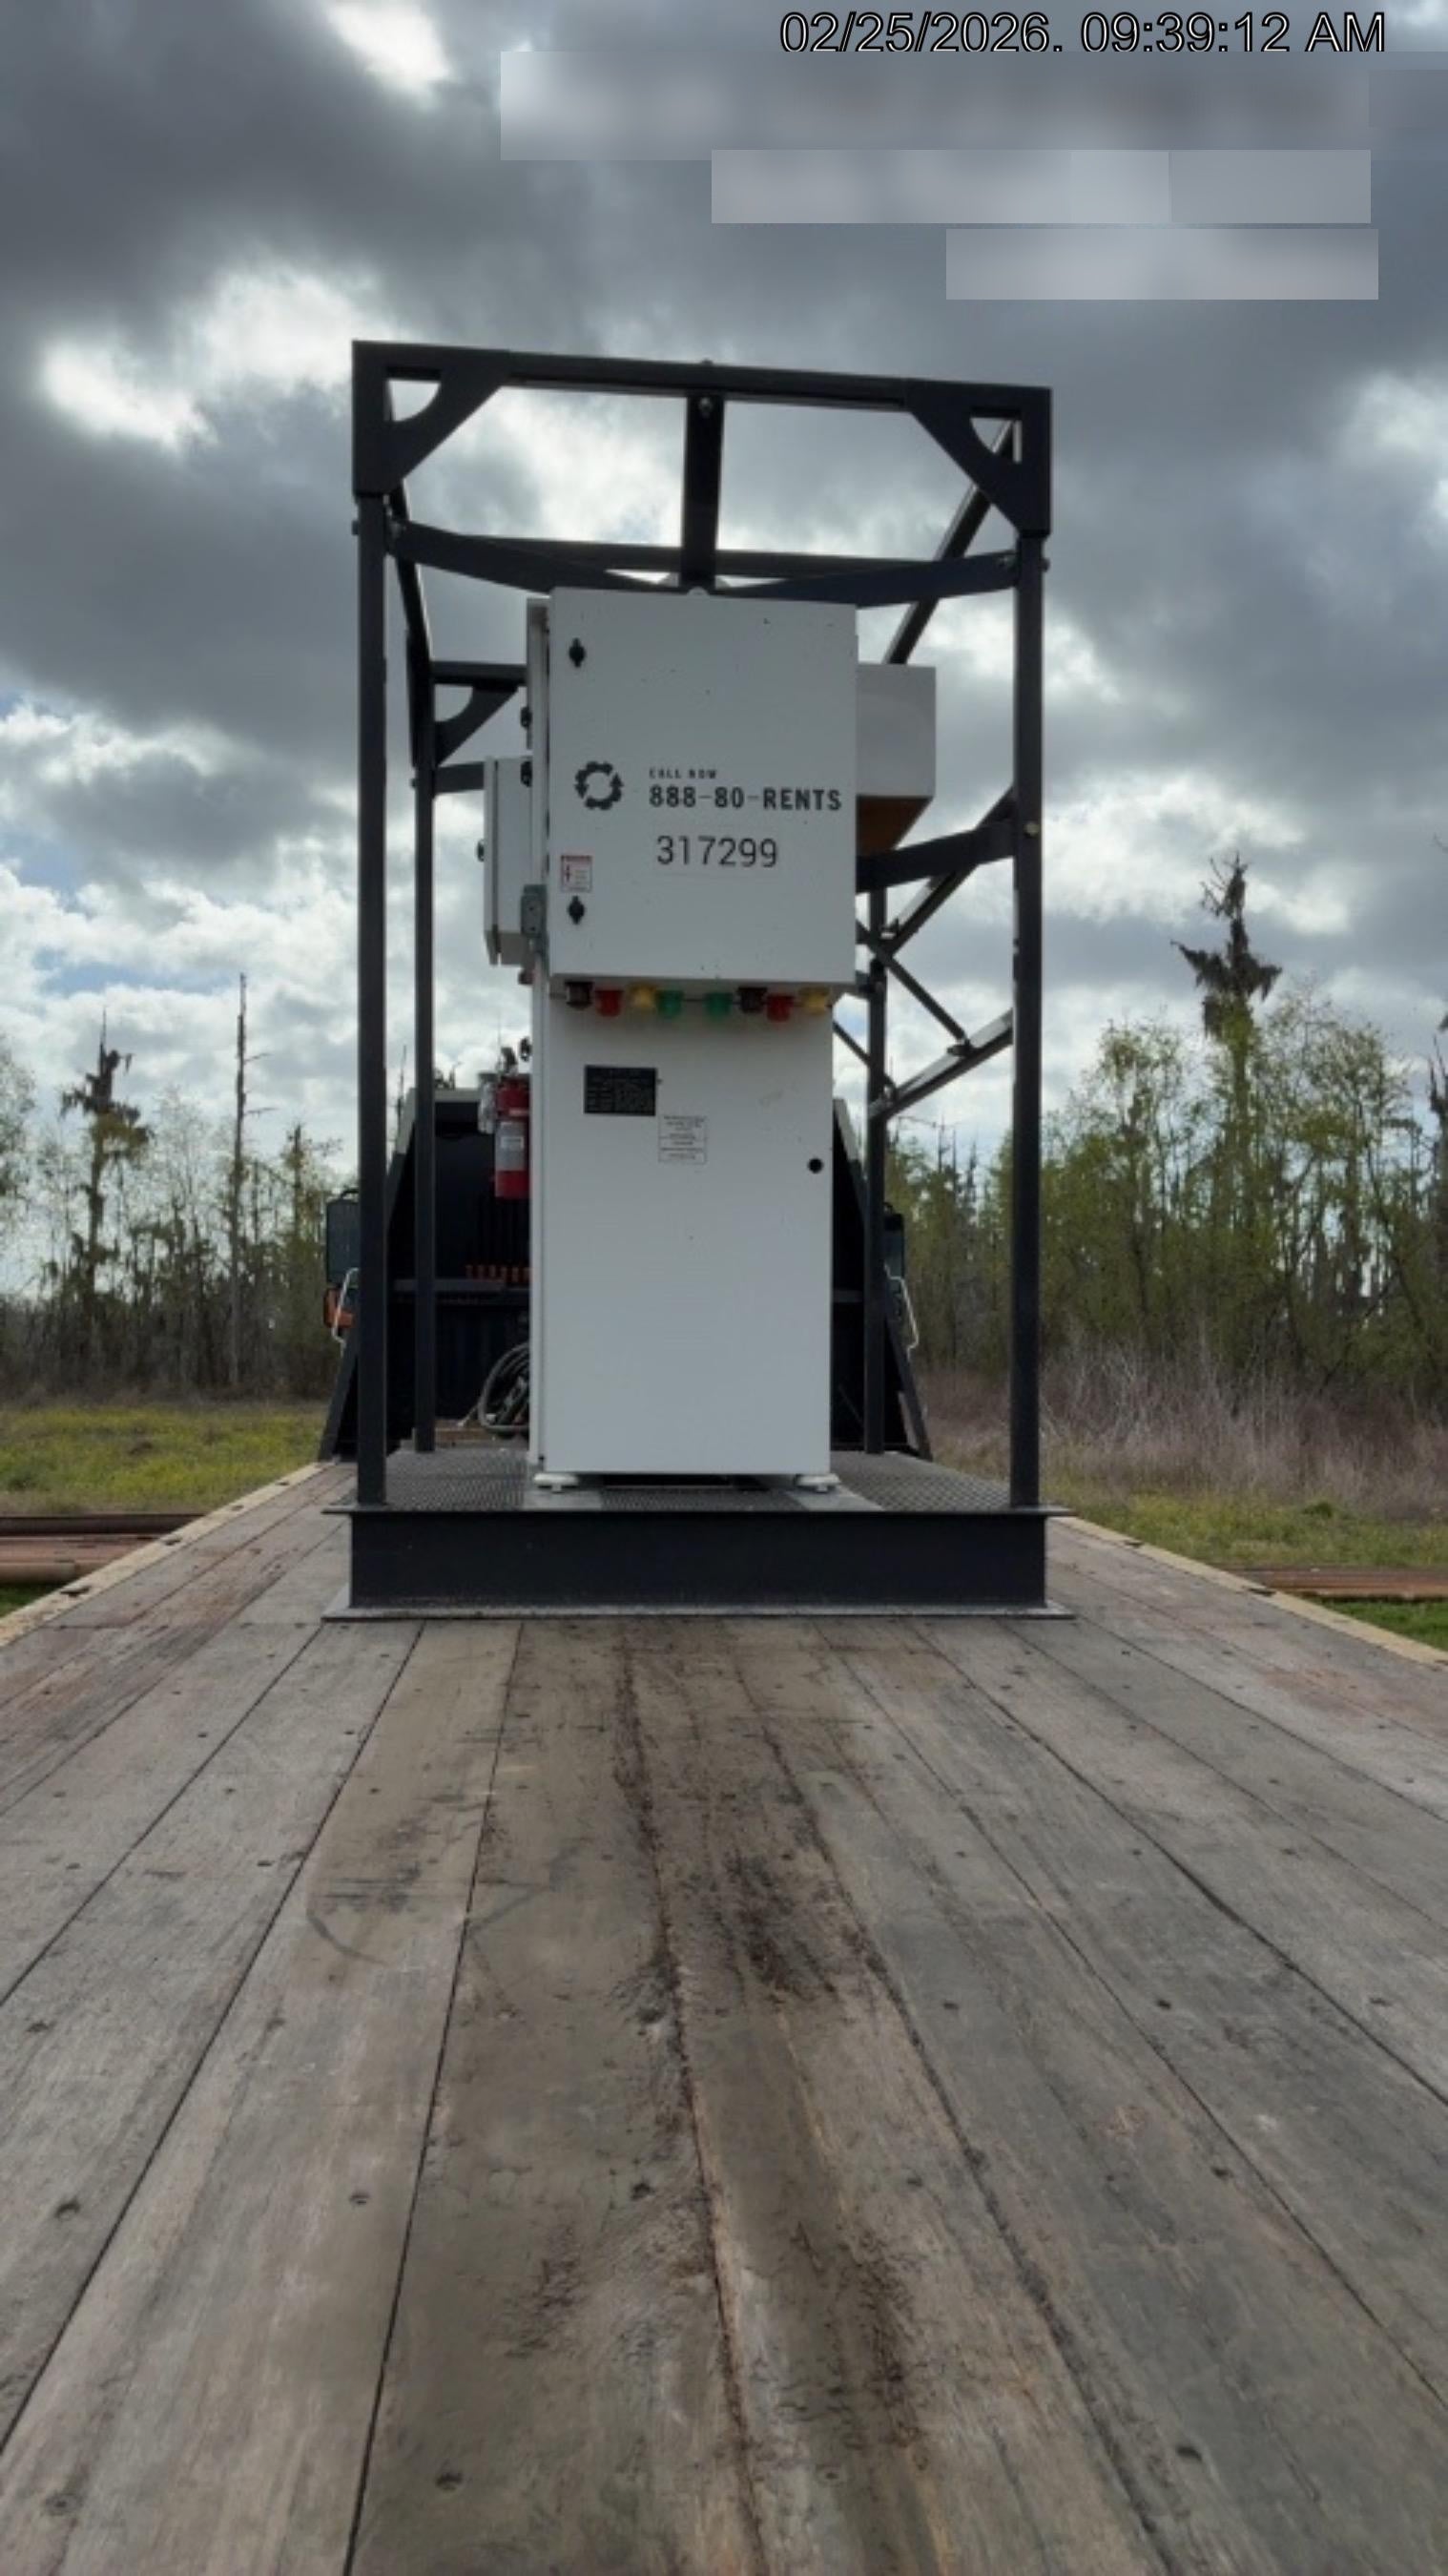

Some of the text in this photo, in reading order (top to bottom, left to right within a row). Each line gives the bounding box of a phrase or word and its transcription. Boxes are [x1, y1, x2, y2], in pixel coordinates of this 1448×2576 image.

[650, 766, 717, 779] CALL NOW
[649, 784, 842, 811] 888-80-RENTS
[656, 835, 779, 867] 317299
